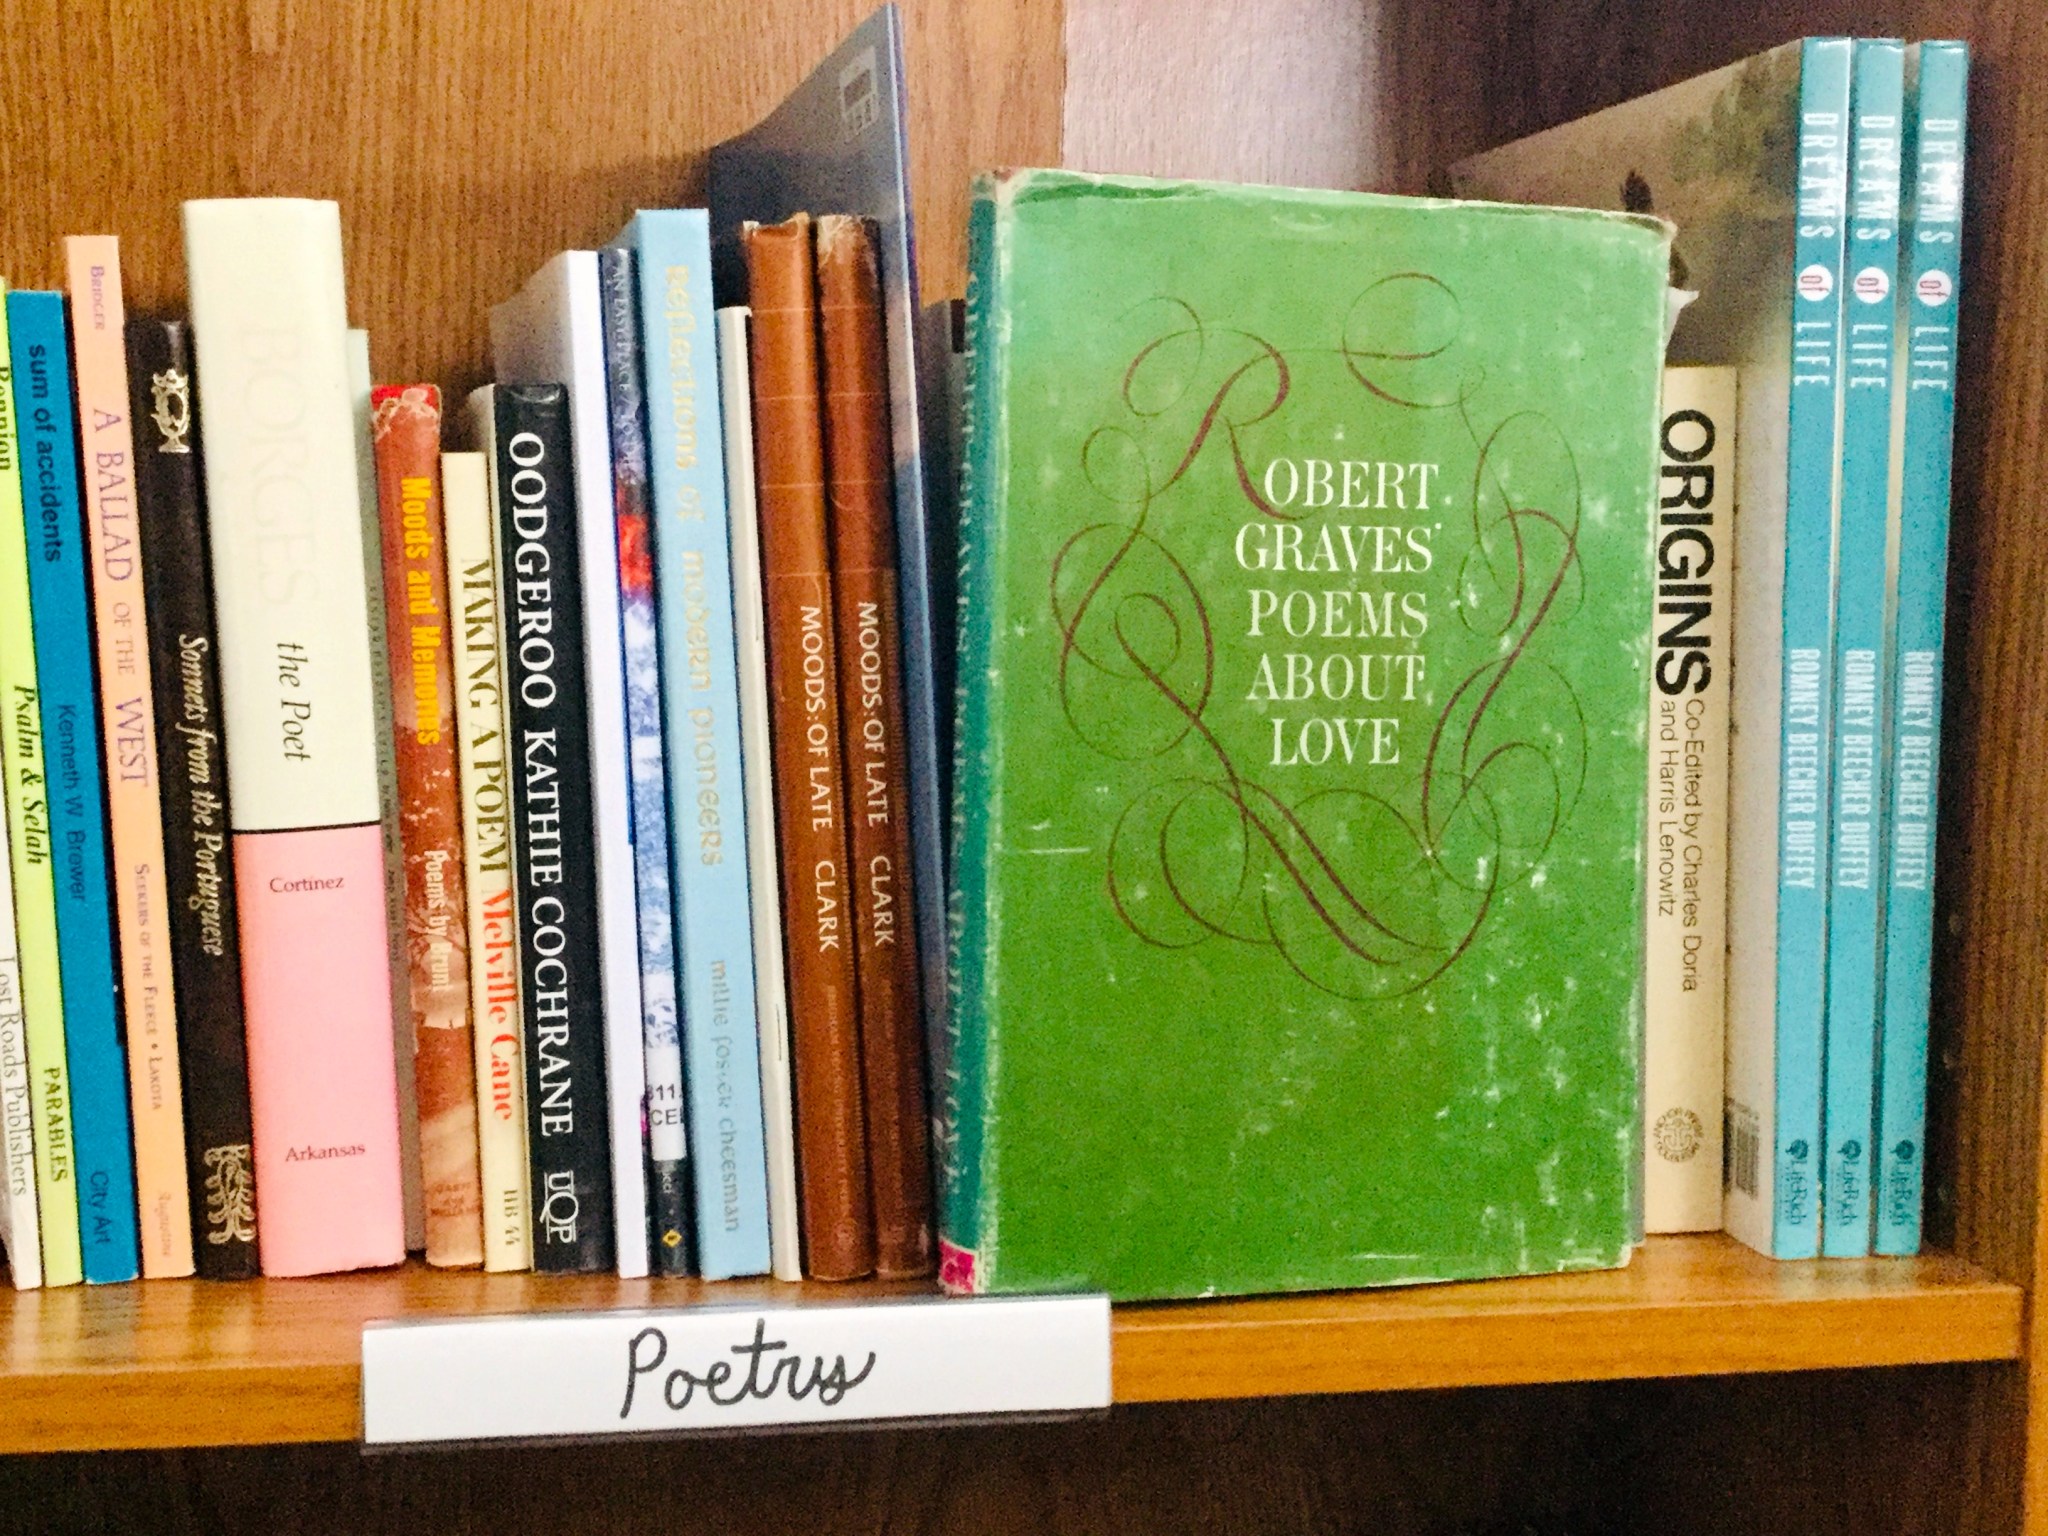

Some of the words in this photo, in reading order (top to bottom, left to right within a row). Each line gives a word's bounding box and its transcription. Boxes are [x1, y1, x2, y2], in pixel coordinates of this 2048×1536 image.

[1800, 113, 1839, 238] DREAMS
[1856, 116, 1895, 240] DREAMS
[1919, 119, 1959, 243] DREAMS
[29, 345, 47, 399] sum
[1794, 322, 1832, 386] LIFE
[1850, 324, 1888, 388] LIFE
[1912, 326, 1949, 391] LIFE
[36, 405, 53, 436] of
[94, 409, 122, 433] A
[38, 440, 62, 562] accidents
[97, 451, 134, 581] BALLAD
[400, 476, 433, 557] Moods
[509, 432, 558, 711] OODGEROO
[1655, 409, 1716, 696] ORIGINS
[114, 602, 131, 628] OF
[407, 570, 437, 614] and
[1246, 589, 1429, 639] POEMS
[115, 638, 136, 675] THE
[277, 641, 309, 687] the
[460, 559, 498, 709] MAKING
[178, 634, 208, 722] Sonnets
[1245, 653, 1427, 701] ABOUT
[1789, 649, 1821, 726] ROMNEY
[1843, 650, 1876, 728] ROMNEY
[1902, 651, 1935, 729] ROMNEY
[14, 686, 37, 758] Psalm
[55, 704, 80, 790] Kenneth
[116, 698, 149, 787] WEST
[177, 722, 216, 783] from
[280, 701, 311, 761] Poet
[471, 720, 497, 750] A
[1269, 718, 1400, 766] LOVE
[1659, 701, 1679, 741] and
[1684, 699, 1704, 807] Co-Edited
[190, 790, 220, 824] the
[524, 730, 563, 887] KATHIE
[809, 766, 833, 832] LATE
[865, 760, 889, 828] LATE
[1659, 750, 1679, 814] Harris
[1787, 733, 1818, 814] BEECHER
[1841, 735, 1873, 815] BEECHER
[22, 798, 50, 865] Selah
[472, 754, 502, 874] POEM
[1679, 810, 1702, 841] by
[189, 830, 223, 956] Portuguese
[1658, 820, 1678, 917] Lenowitz
[1682, 845, 1703, 929] Charles
[1785, 820, 1817, 889] DUFFEY
[1839, 822, 1871, 890] DUFFEY
[814, 860, 839, 953] CLARK
[870, 855, 895, 947] CLARK
[481, 889, 517, 1024] Melville
[1682, 935, 1702, 993] Doria
[1, 1012, 26, 1077] Roads
[530, 896, 573, 1137] COCHRANE
[490, 1036, 518, 1121] Cane
[6, 1084, 33, 1197] Publishers
[43, 1067, 69, 1182] PARABLES
[285, 1140, 365, 1163] Arkansas
[540, 1171, 580, 1245] UQP
[619, 1318, 877, 1420] Poetry
